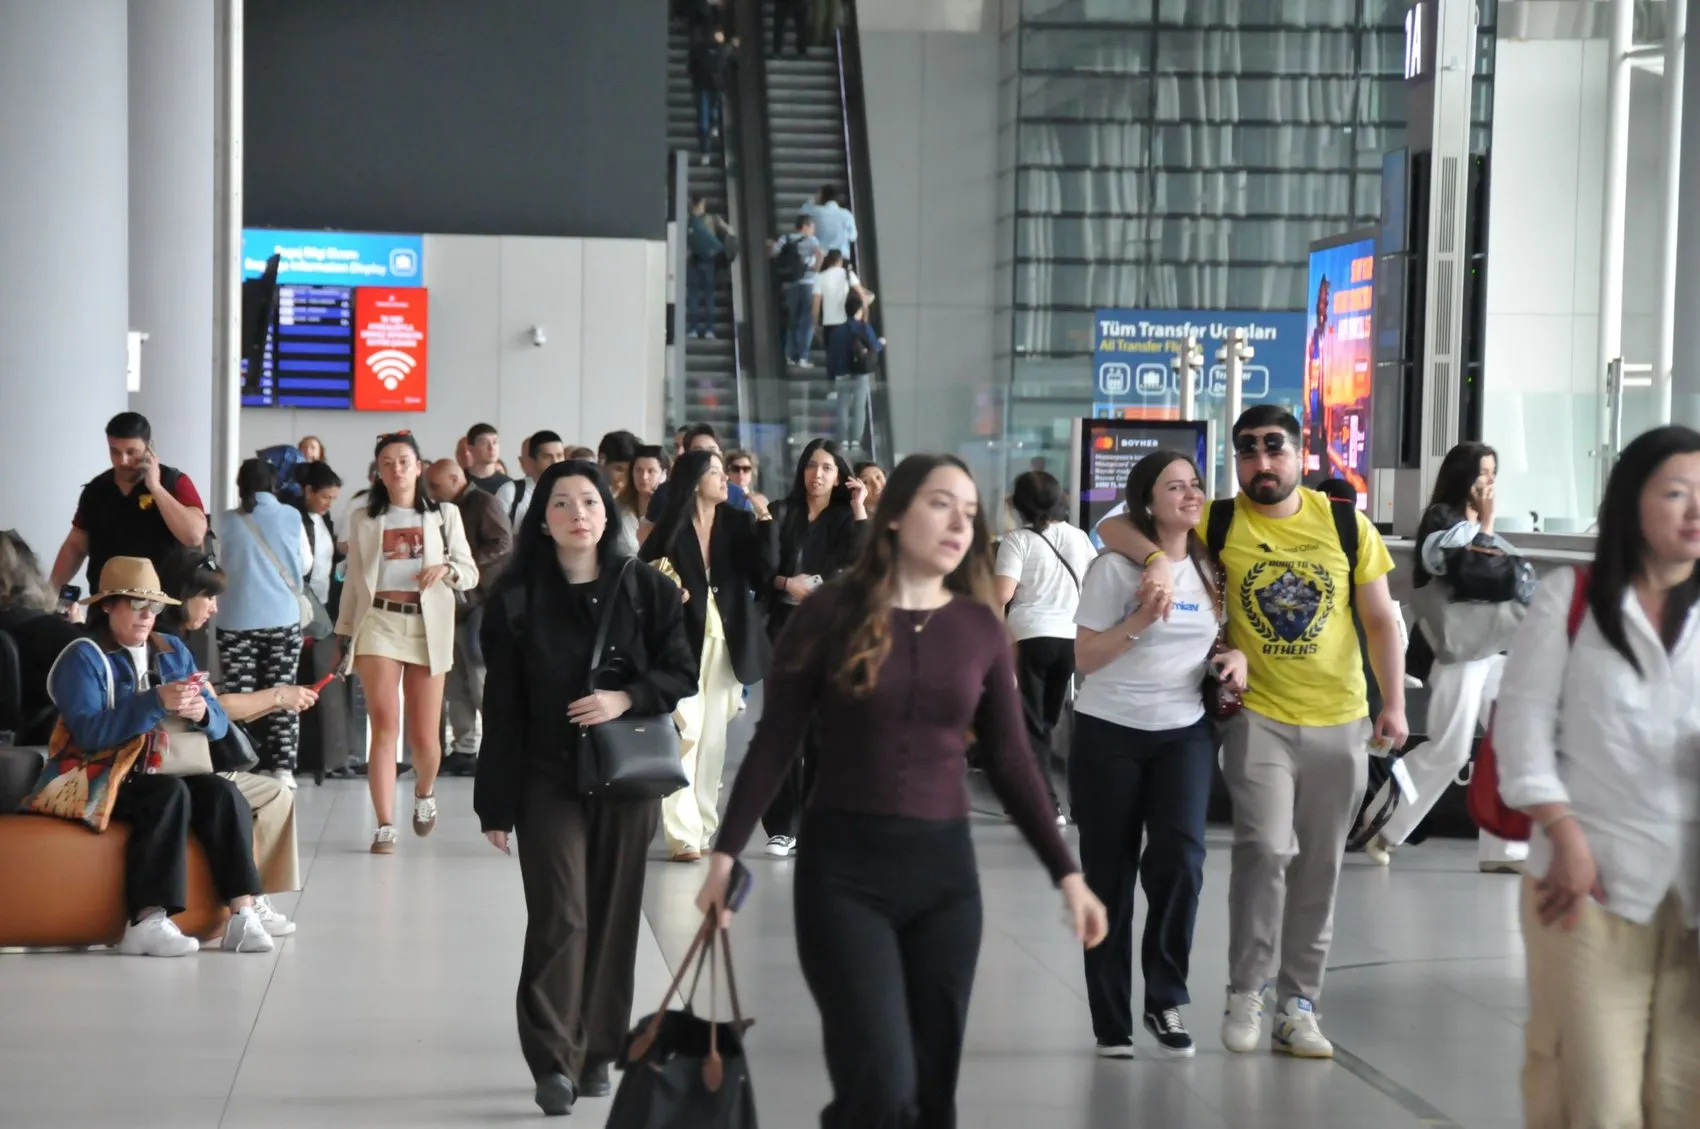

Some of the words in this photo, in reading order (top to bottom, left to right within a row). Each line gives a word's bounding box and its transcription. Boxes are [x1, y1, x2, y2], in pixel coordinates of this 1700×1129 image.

[1404, 2, 1422, 80] 1A
[1100, 321, 1136, 338] Tüm
[1138, 321, 1207, 339] Transfer
[1099, 340, 1115, 352] All
[1117, 340, 1162, 352] Transfer
[1120, 438, 1159, 448] BOYNER
[1262, 643, 1319, 655] ATHENS
